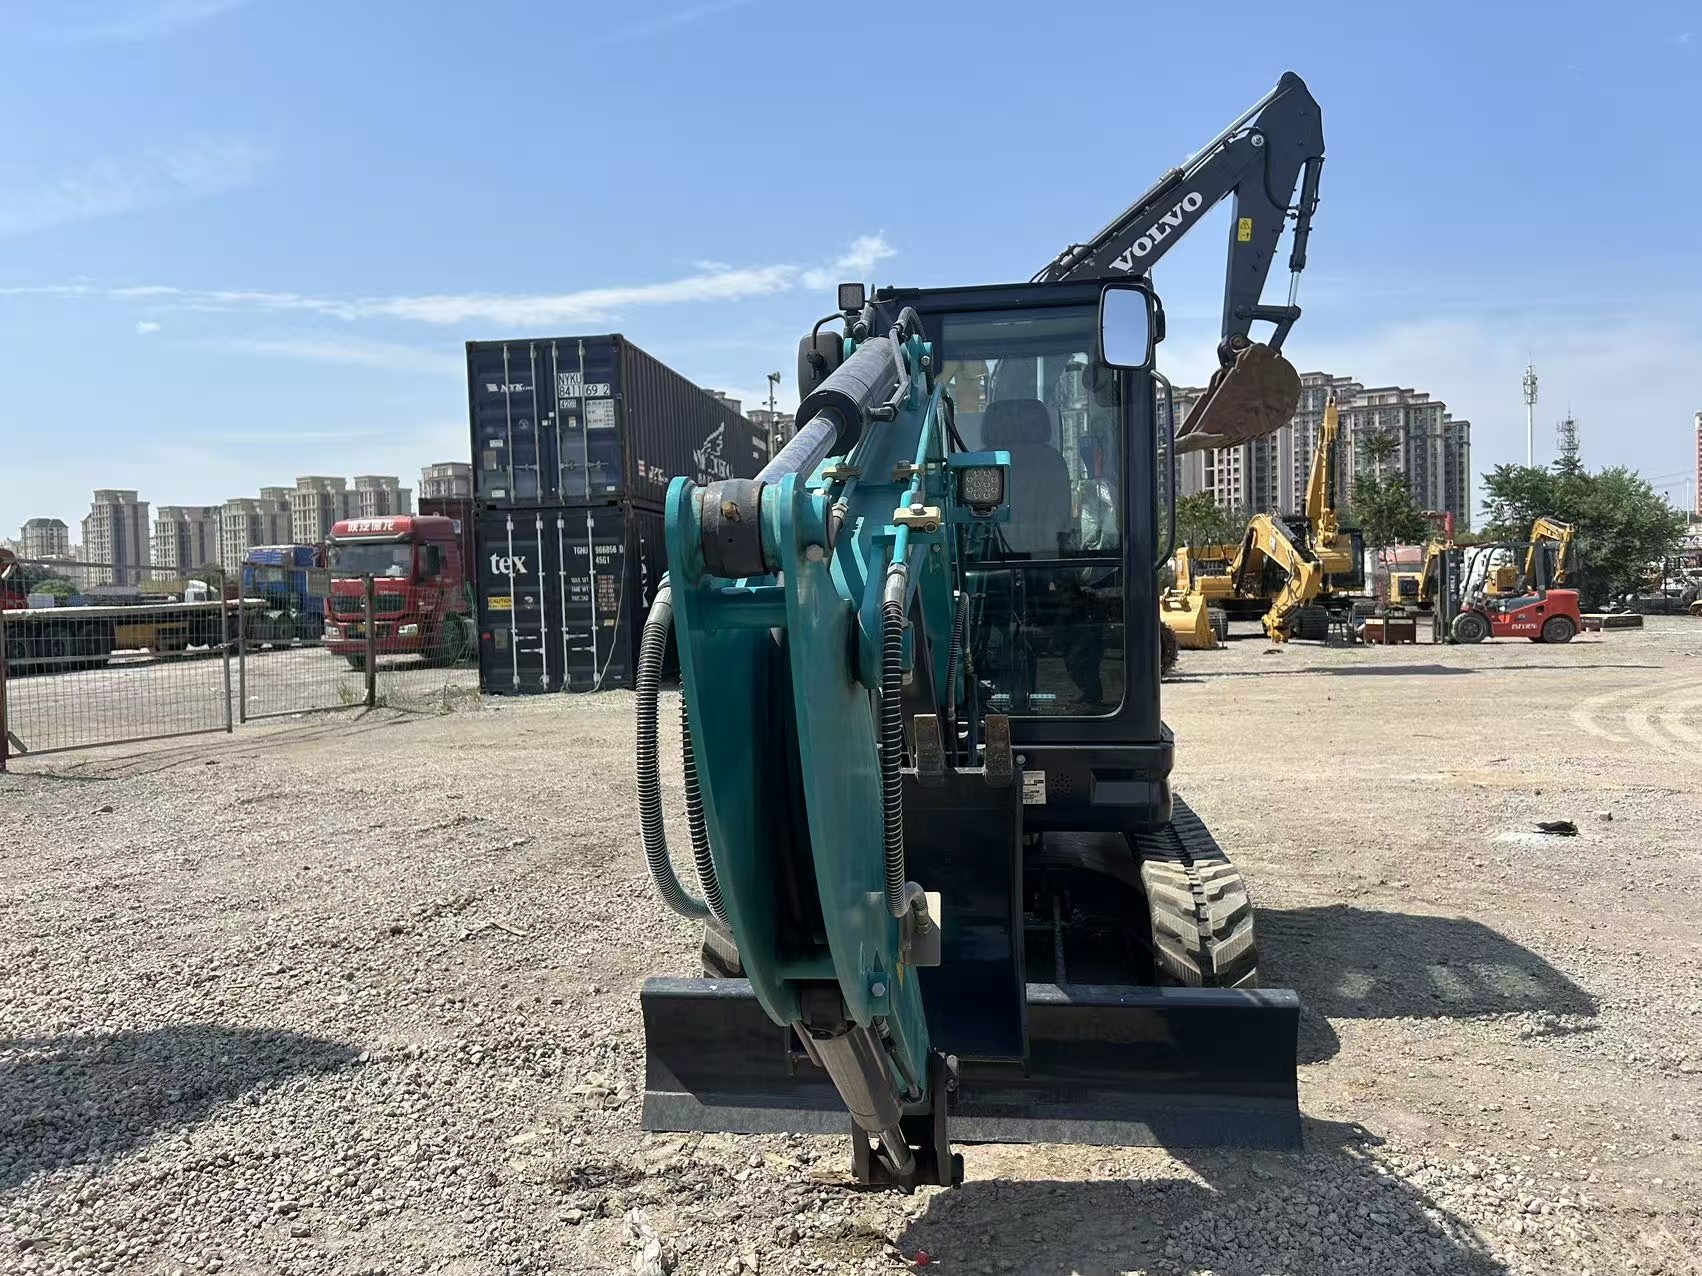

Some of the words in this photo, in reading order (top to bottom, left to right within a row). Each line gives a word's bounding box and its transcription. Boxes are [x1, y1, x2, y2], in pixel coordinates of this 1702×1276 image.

[1109, 191, 1203, 272] VOLVO
[558, 373, 582, 385] NYKU
[559, 385, 581, 397] 8411
[585, 384, 598, 396] 69
[603, 384, 609, 395] 2
[490, 552, 528, 575] tex
